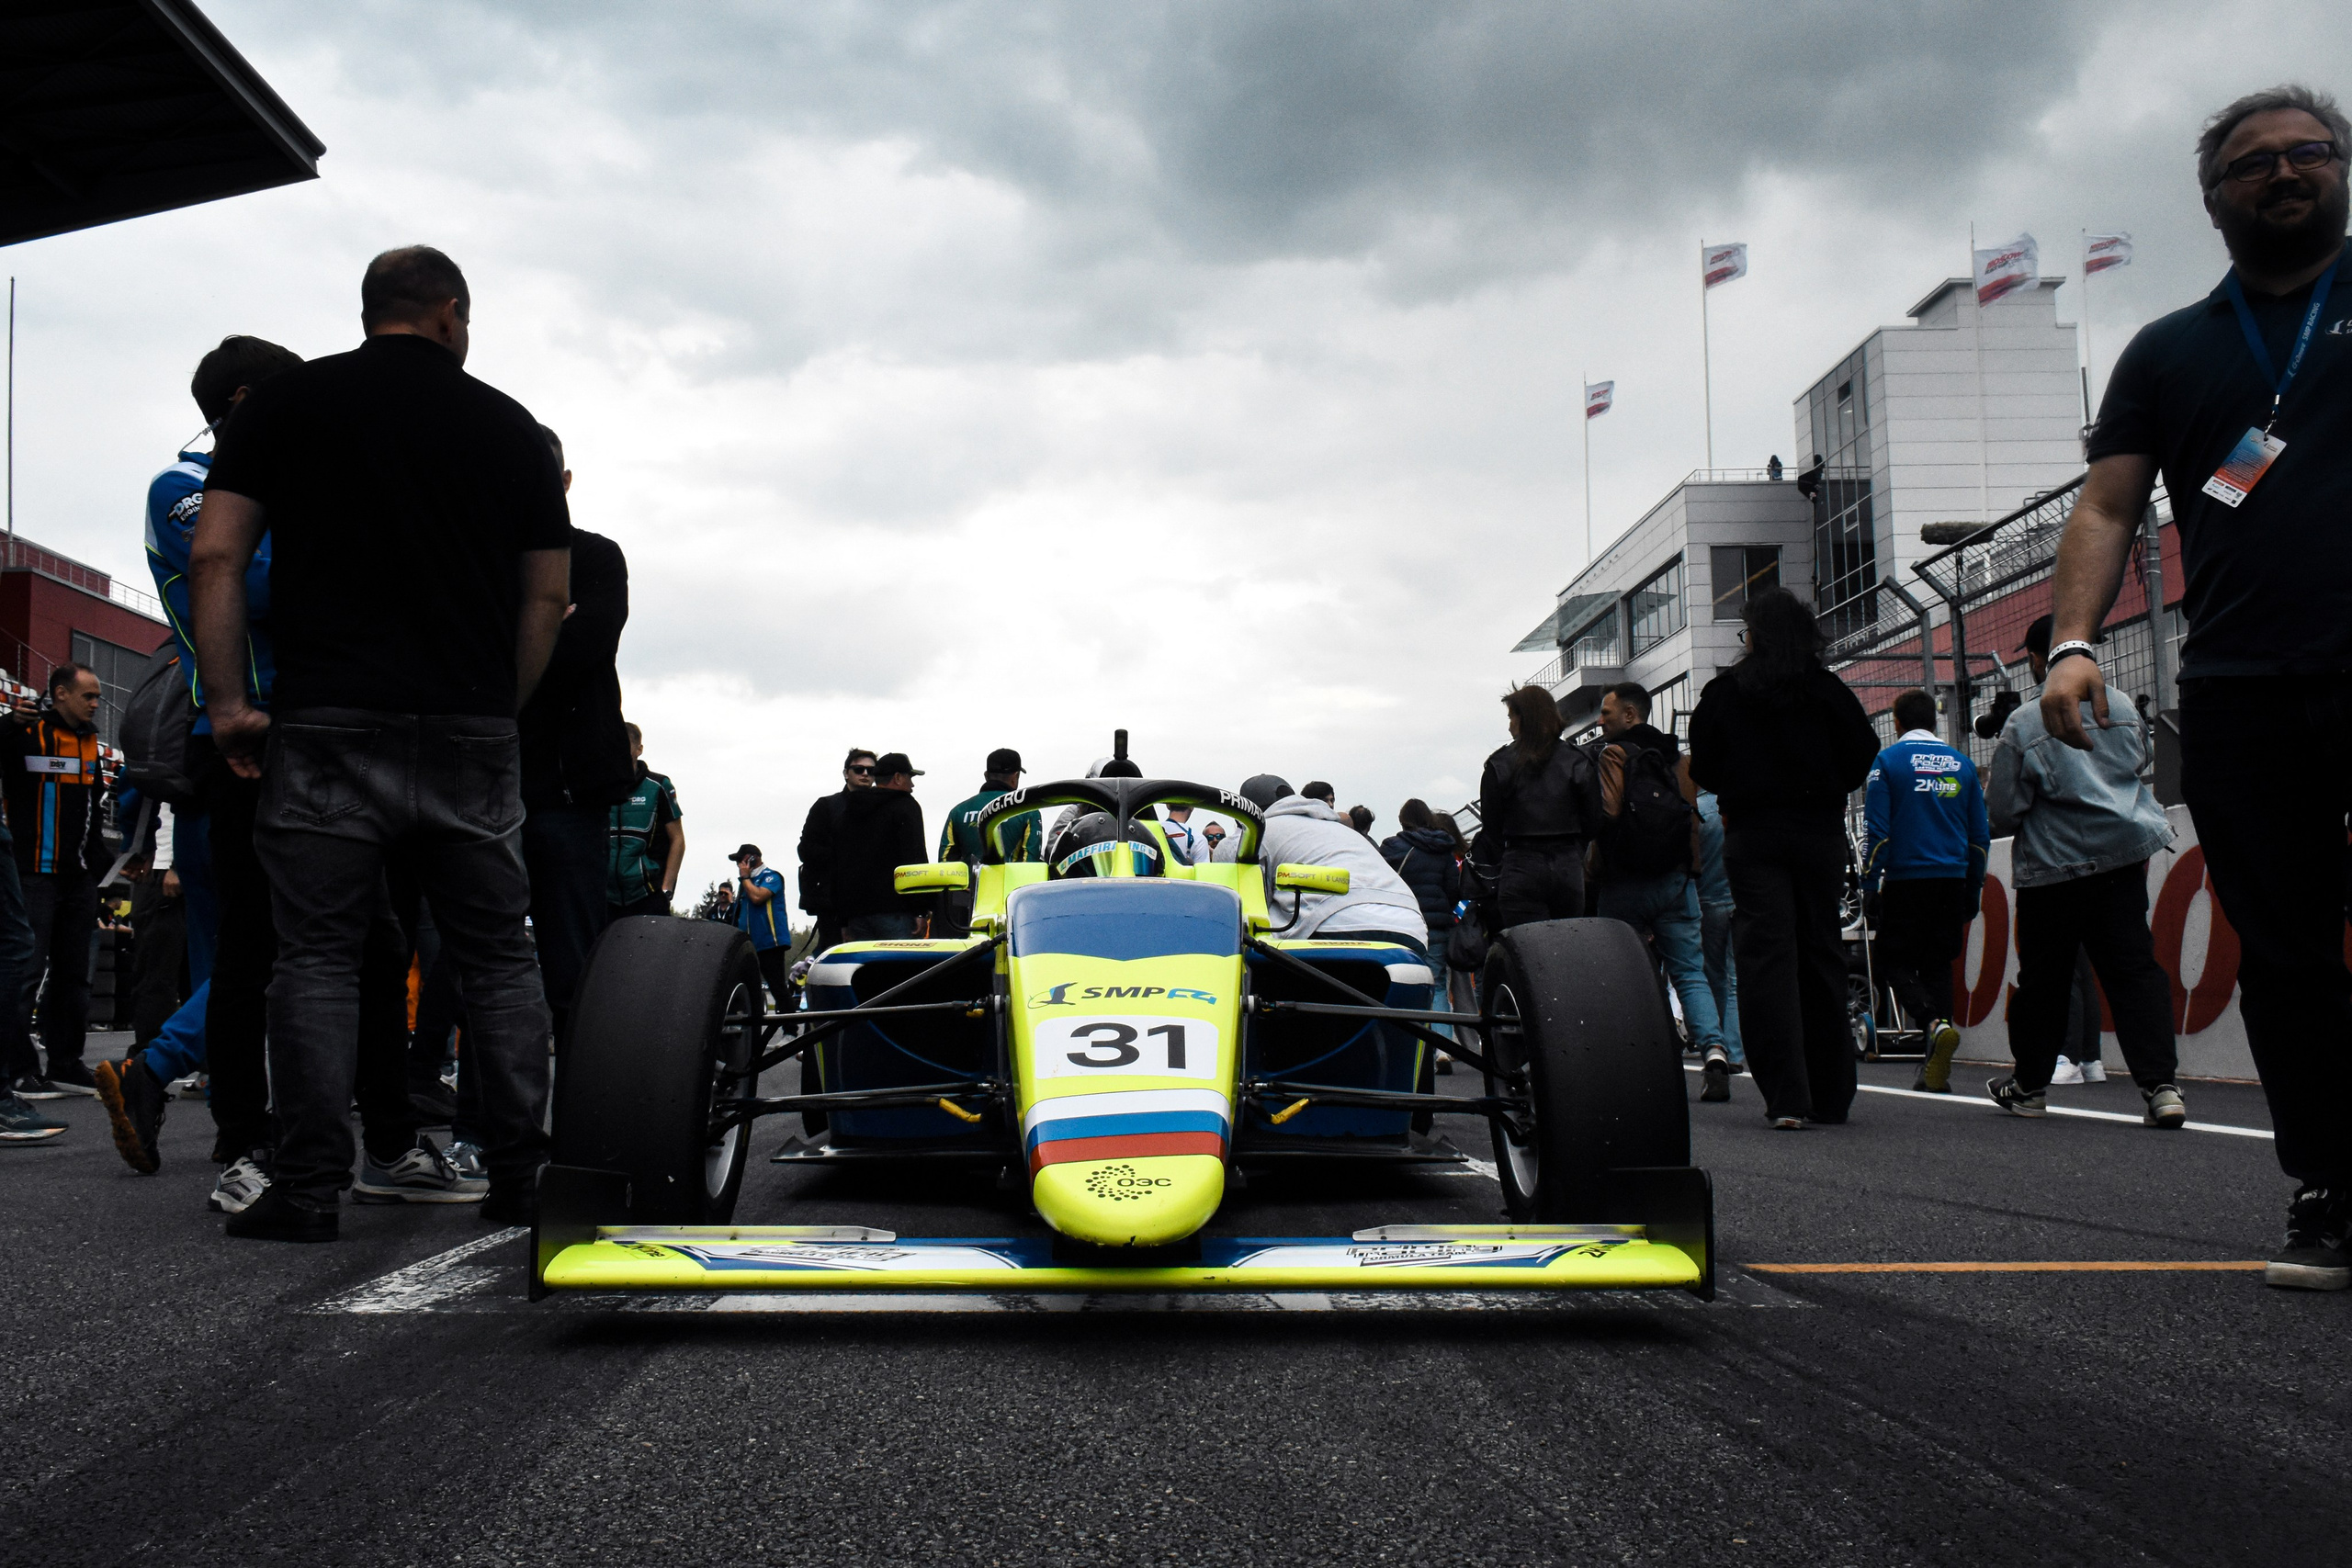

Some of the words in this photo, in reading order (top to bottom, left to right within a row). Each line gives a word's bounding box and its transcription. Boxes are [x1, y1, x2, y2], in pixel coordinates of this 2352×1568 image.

[2307, 302, 2321, 327] RACING
[1080, 987, 1166, 999] SMP
[1166, 987, 1217, 1006] F4
[1067, 1021, 1186, 1070] 31
